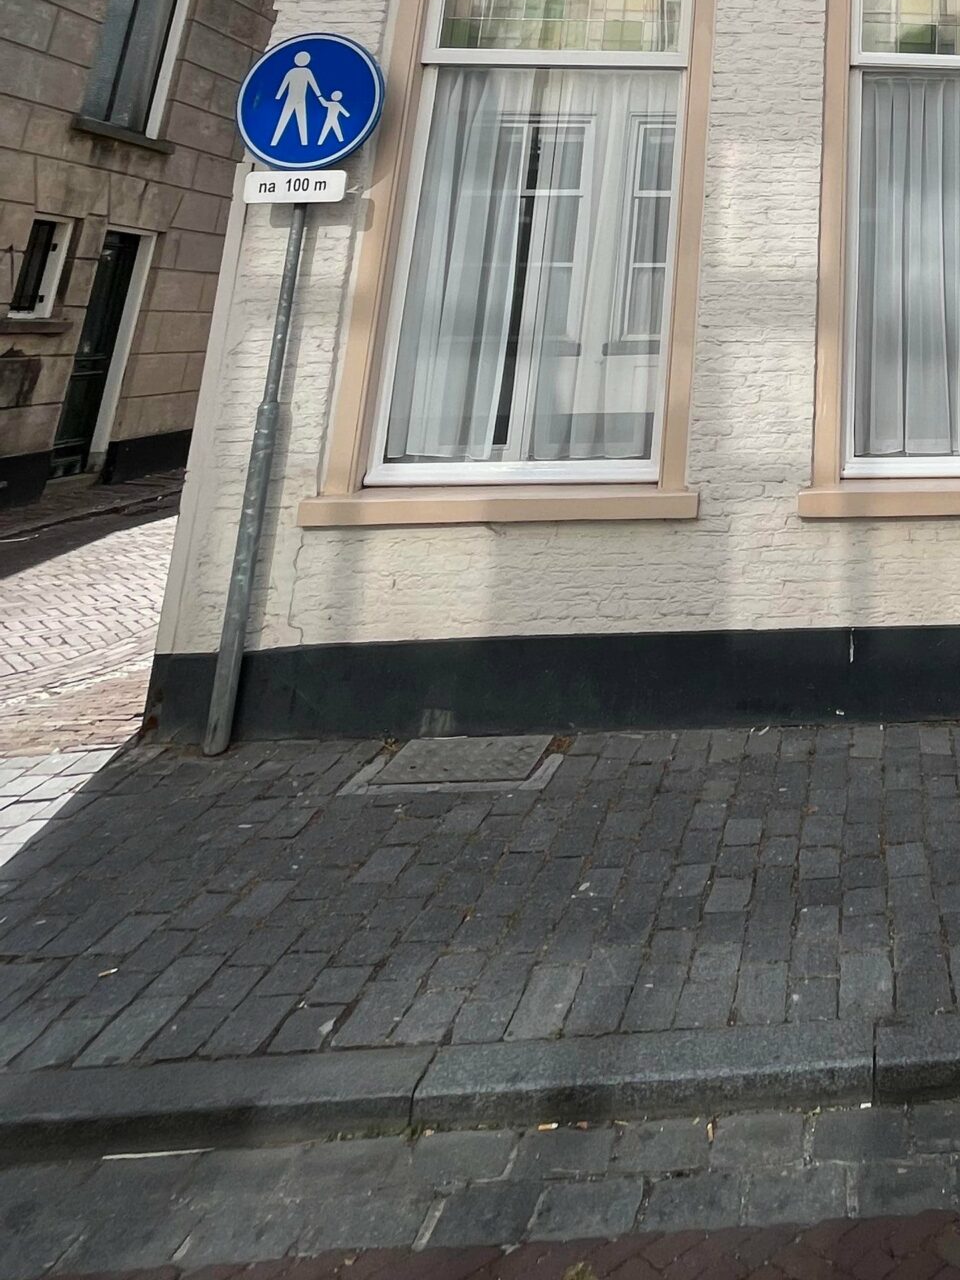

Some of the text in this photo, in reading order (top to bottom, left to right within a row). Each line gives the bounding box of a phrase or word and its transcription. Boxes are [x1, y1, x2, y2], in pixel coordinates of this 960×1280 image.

[258, 178, 327, 193] na 100 m
